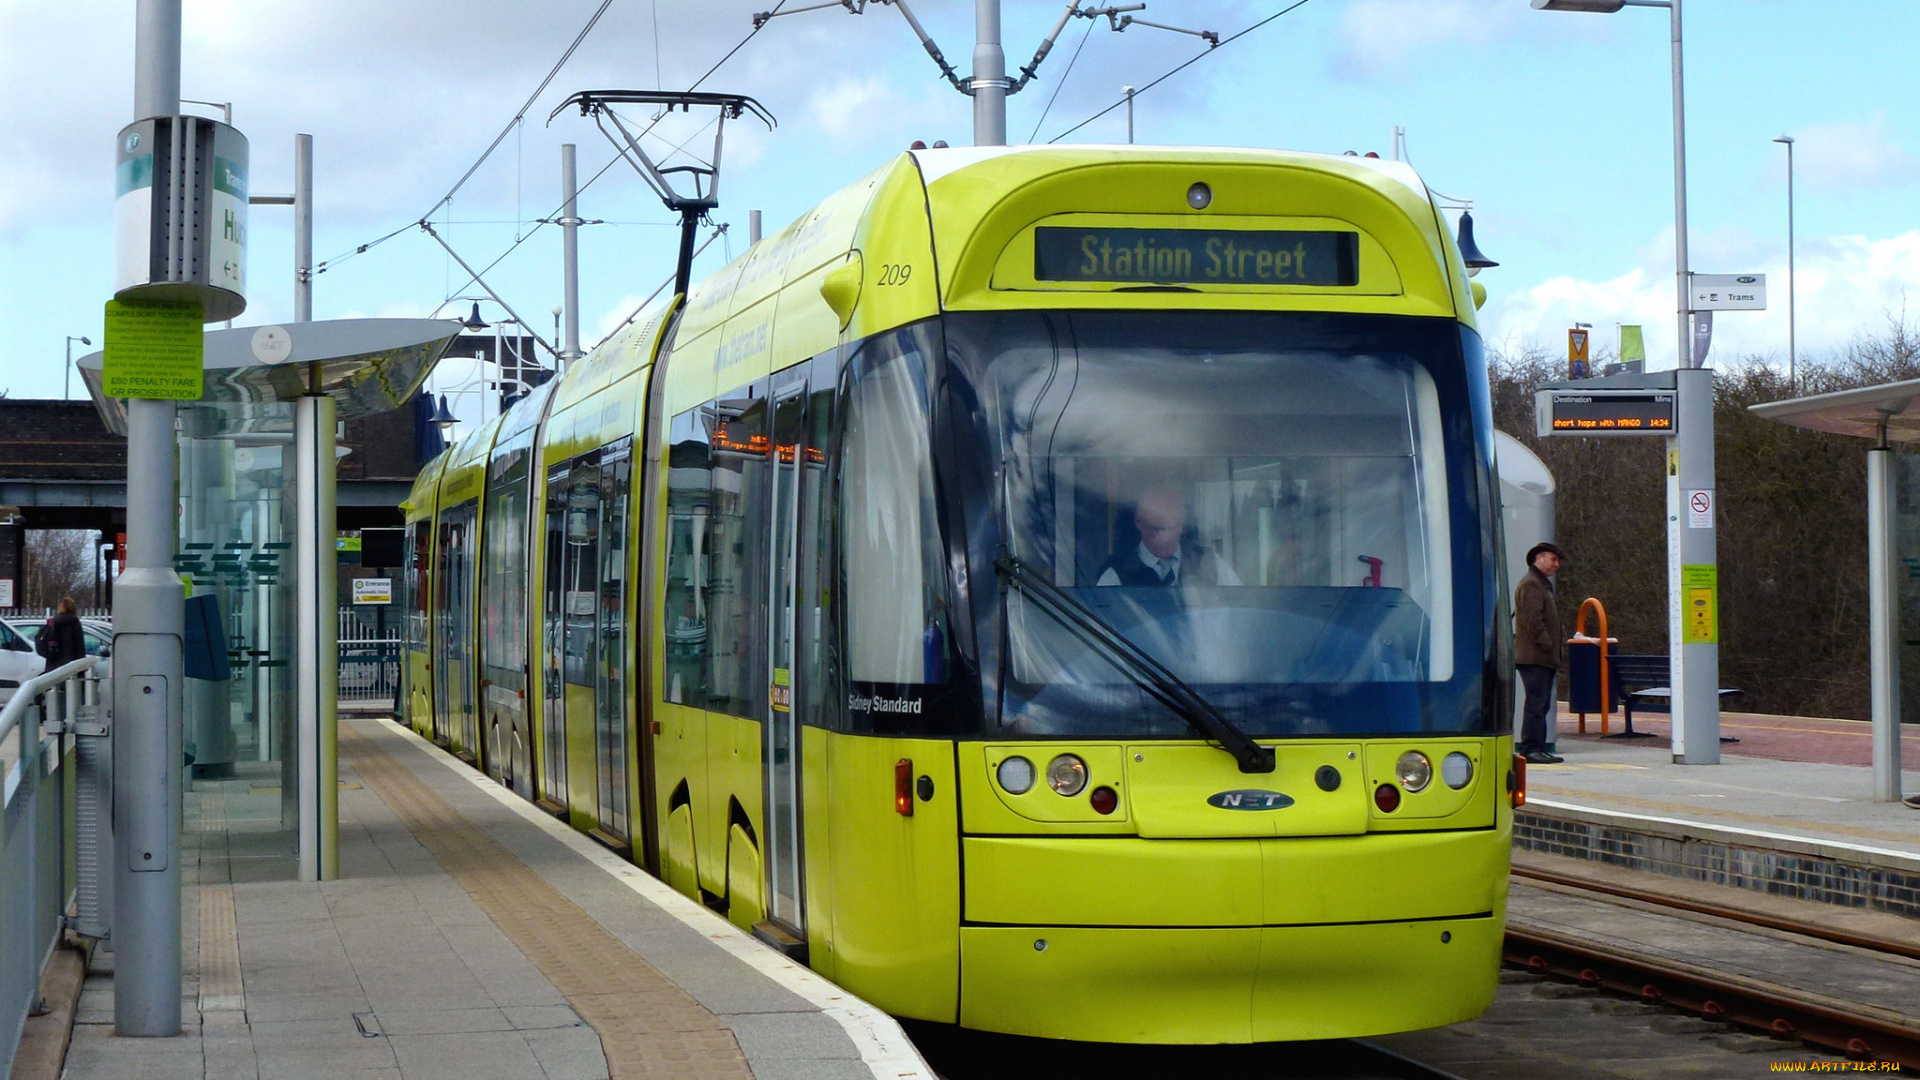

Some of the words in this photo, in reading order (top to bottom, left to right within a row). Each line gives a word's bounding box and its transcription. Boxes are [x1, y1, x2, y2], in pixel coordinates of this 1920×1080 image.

[1081, 235, 1192, 276] Station
[1205, 237, 1306, 279] Street
[877, 264, 911, 286] 209
[1728, 293, 1754, 301] Trams
[129, 377, 170, 387] PENALTY
[172, 378, 196, 387] FARE
[110, 388, 125, 396] OR
[127, 388, 196, 398] PROSECUTION
[1553, 395, 1592, 403] Destination
[1654, 395, 1671, 403] Mins
[1577, 419, 1596, 429] hops
[1599, 419, 1614, 427] with
[1617, 419, 1641, 427] MANGO
[1650, 418, 1669, 427] 14:34
[848, 694, 872, 714] Sidney
[873, 695, 921, 714] Standard
[1221, 794, 1280, 807] NET
